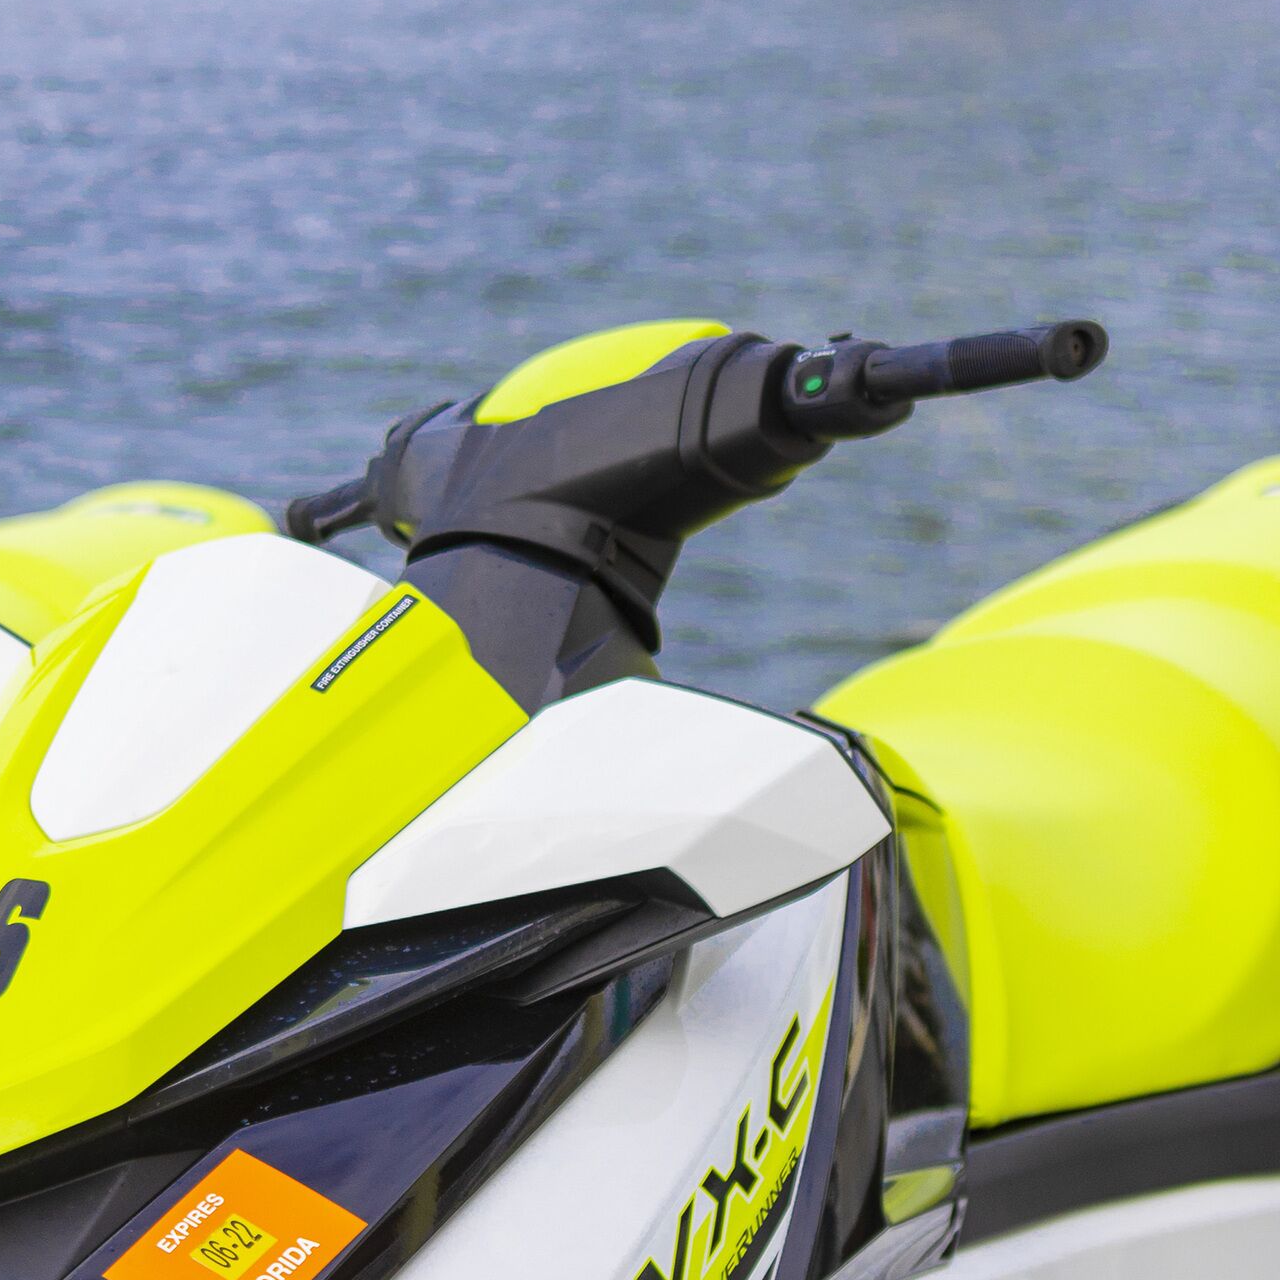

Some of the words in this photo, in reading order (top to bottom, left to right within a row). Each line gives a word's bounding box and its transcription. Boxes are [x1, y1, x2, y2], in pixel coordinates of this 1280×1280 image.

[316, 671, 335, 690] FIRE
[330, 628, 380, 674] EXTINGUISHER
[375, 597, 414, 632] CONTAINER
[155, 1192, 226, 1255] EXPIRES
